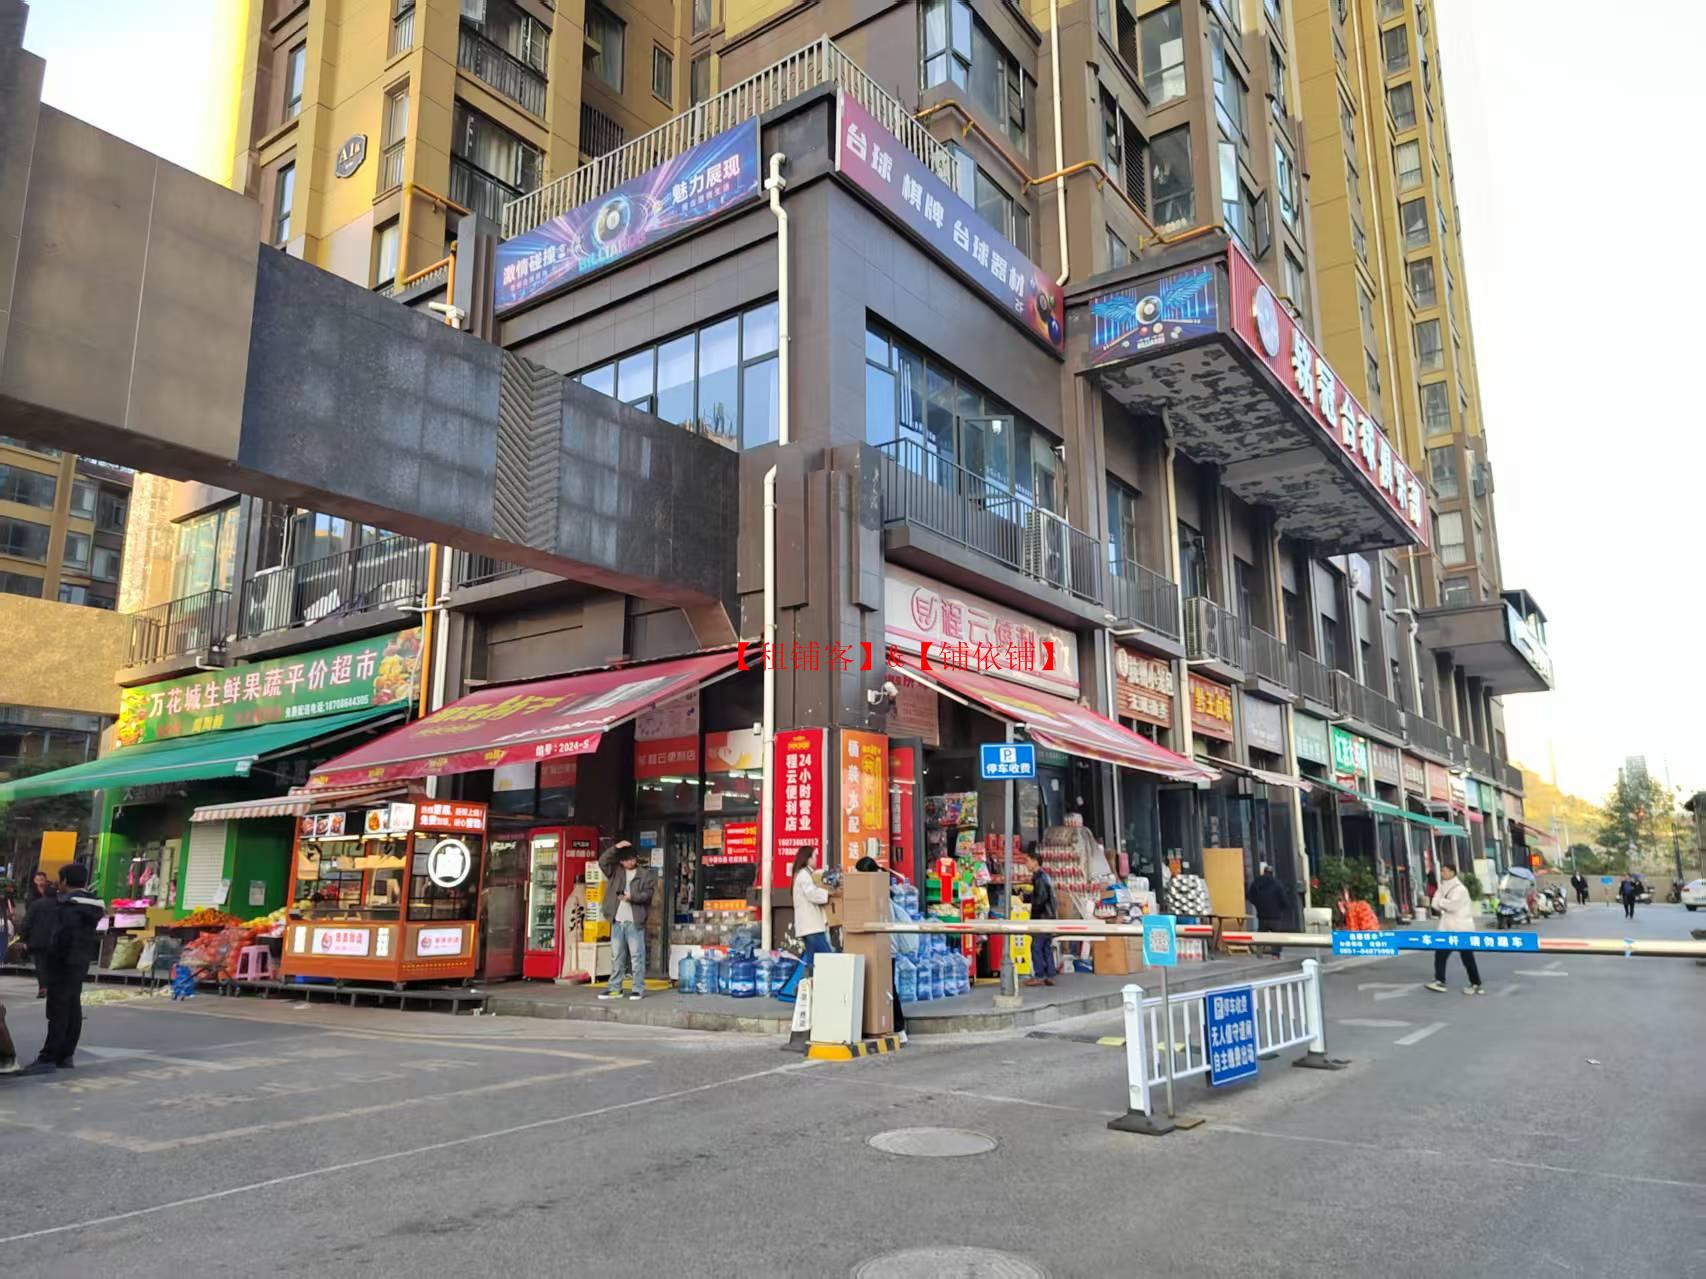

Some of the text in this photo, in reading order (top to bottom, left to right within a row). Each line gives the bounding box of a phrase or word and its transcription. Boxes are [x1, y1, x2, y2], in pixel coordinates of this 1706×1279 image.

[672, 153, 741, 205] 魅力展现
[846, 123, 1026, 297] 台球 棋牌 台球器材
[149, 649, 378, 718] 万花城生鲜果蔬平价超市
[785, 753, 798, 831] 程云便利店
[799, 753, 812, 831] 24小时营业
[986, 763, 1031, 775] 停车收费
[1408, 935, 1459, 946] 一车一杆
[1469, 935, 1524, 948] 请勿跟车
[1223, 995, 1249, 1016] 停车收费
